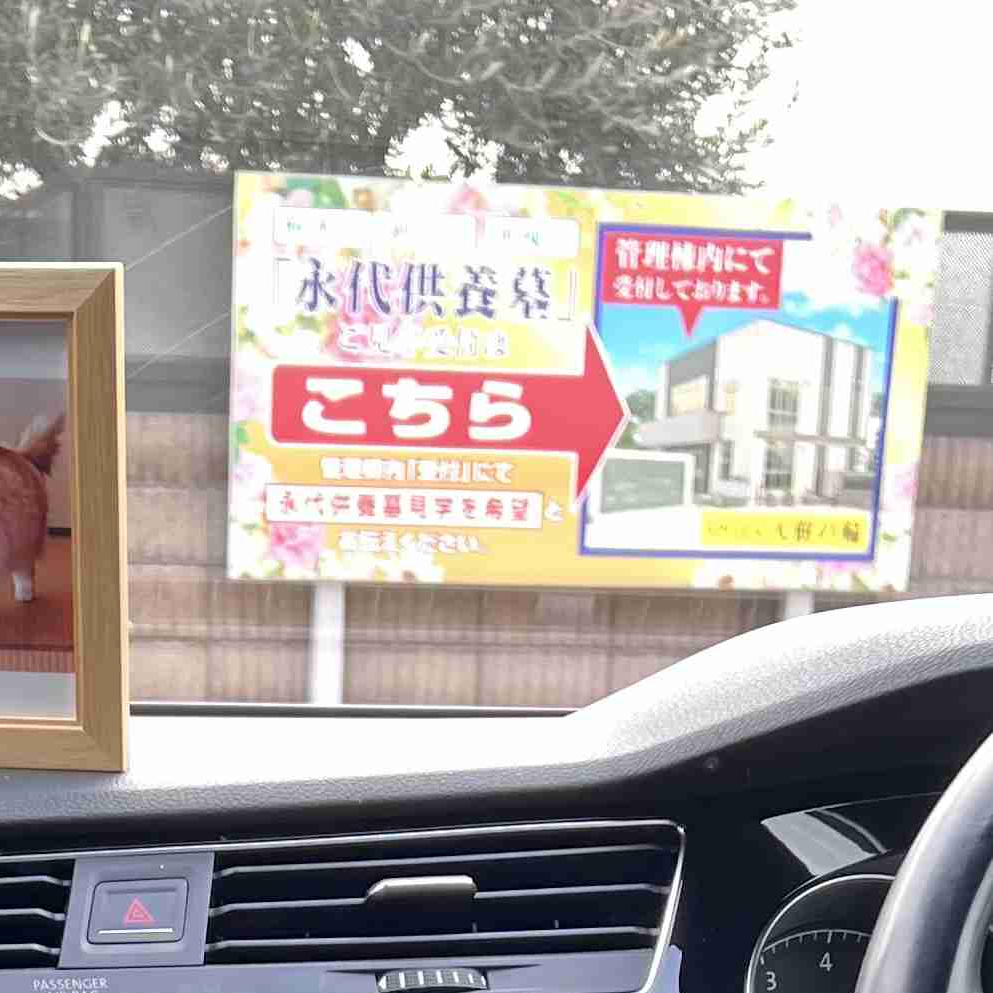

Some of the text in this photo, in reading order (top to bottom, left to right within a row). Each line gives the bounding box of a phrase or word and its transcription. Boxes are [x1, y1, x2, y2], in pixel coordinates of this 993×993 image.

[301, 378, 533, 441] こちら
[819, 952, 832, 971] 4
[32, 977, 110, 991] PASSENGER
[766, 971, 777, 991] 3
